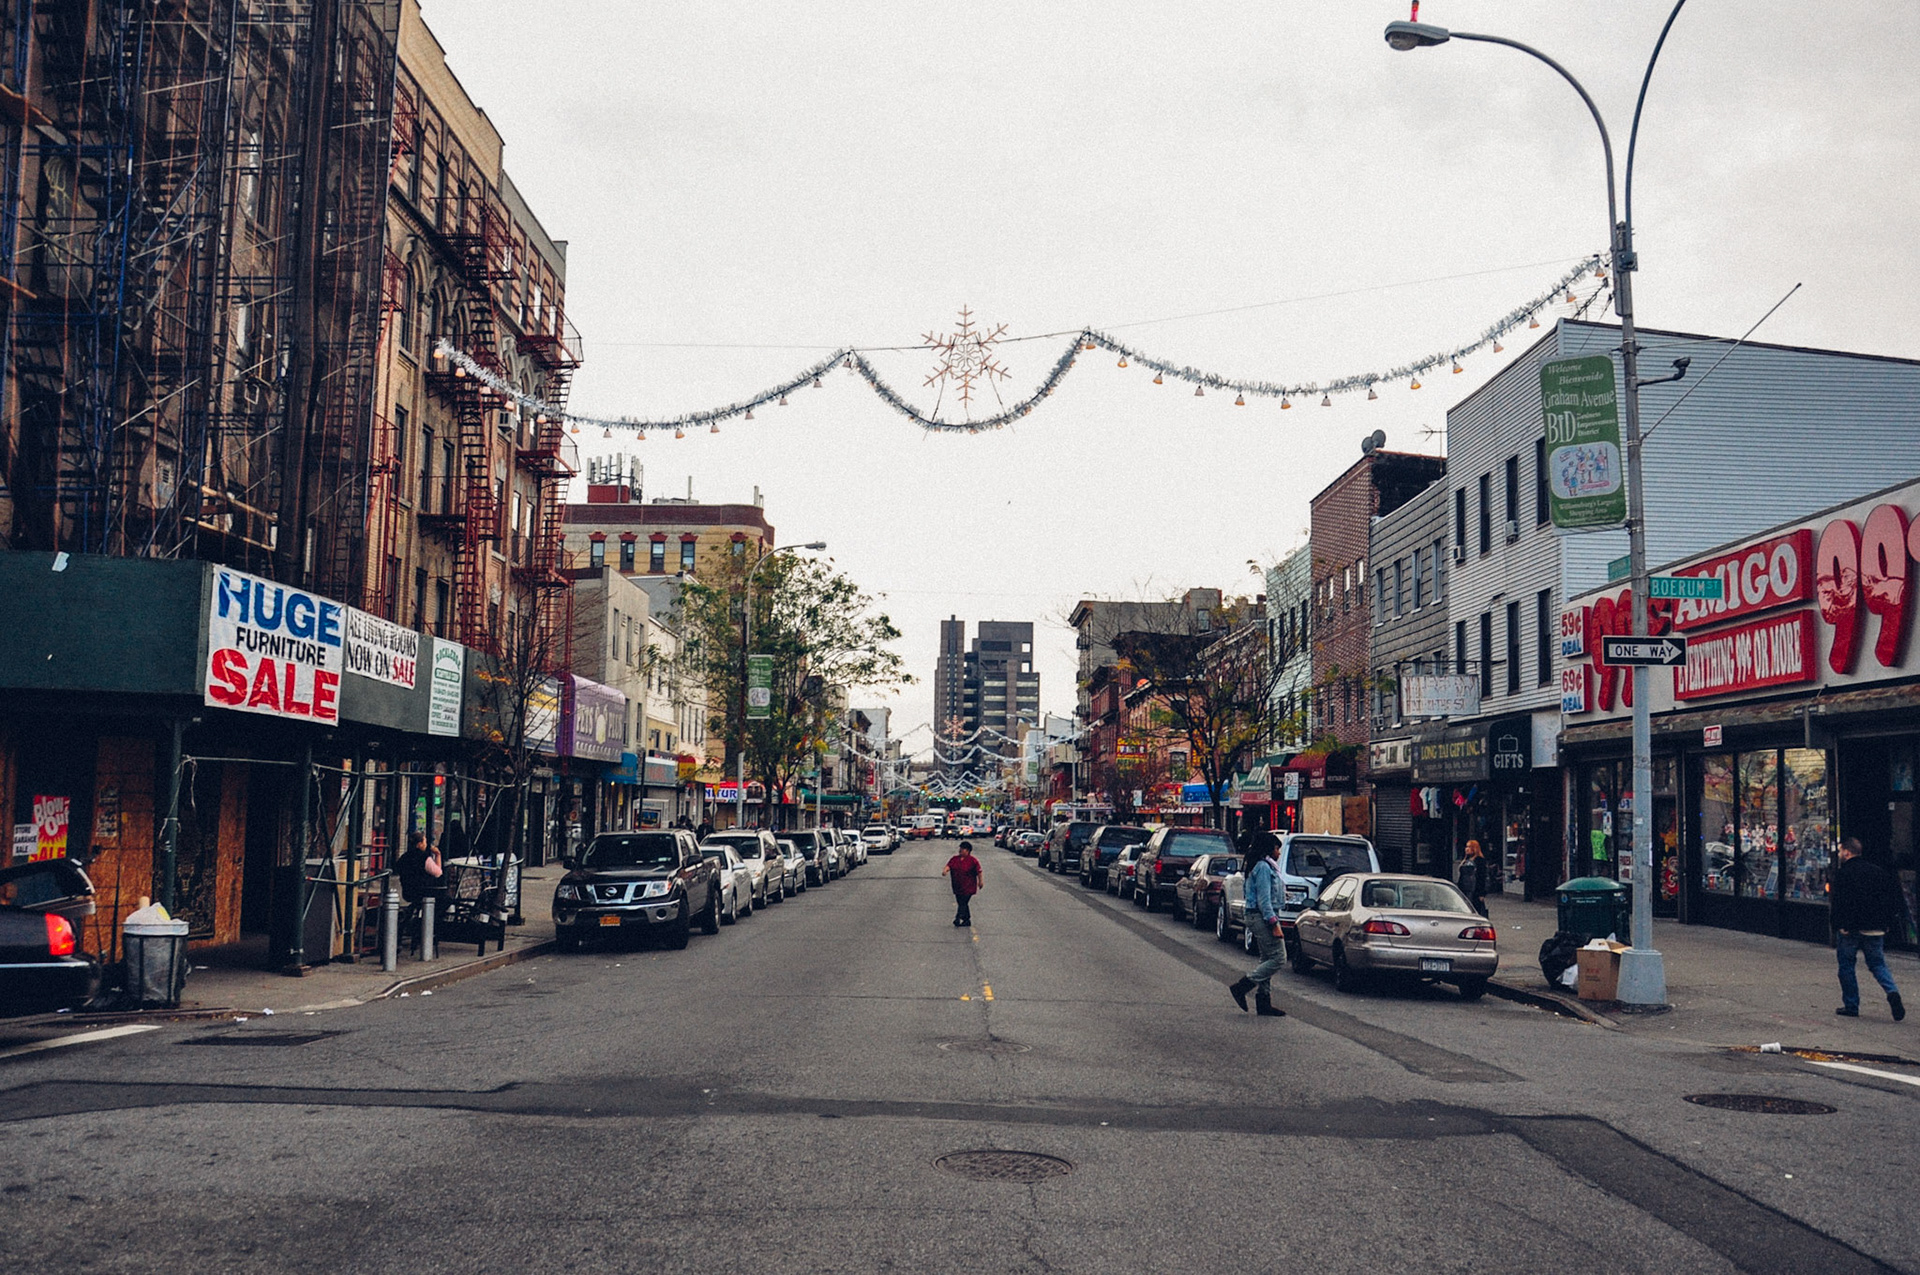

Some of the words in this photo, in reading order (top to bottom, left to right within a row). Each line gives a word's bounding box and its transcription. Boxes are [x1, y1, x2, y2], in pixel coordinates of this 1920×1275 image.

[1544, 387, 1579, 409] Graham
[1581, 390, 1615, 407] Avenue
[1651, 579, 1705, 597] BOERUM
[1707, 581, 1718, 590] ST
[1675, 543, 1798, 625] AMIGO
[218, 571, 341, 647] HUGE
[1561, 610, 1582, 637] 59¢
[236, 626, 326, 667] FURNITURE
[1561, 639, 1582, 656] DEAL
[1615, 645, 1639, 657] ONE
[1650, 646, 1674, 657] WAY
[1678, 636, 1734, 693] EVERYTHING
[1754, 628, 1768, 680] OR
[1770, 620, 1801, 677] MORE
[346, 641, 371, 673] NOW
[375, 651, 391, 679] ON
[392, 655, 416, 687] SALE
[209, 648, 340, 722] SALE
[1561, 668, 1582, 694] 69¢
[1561, 696, 1583, 712] DEAL
[1494, 753, 1524, 769] GIFTS
